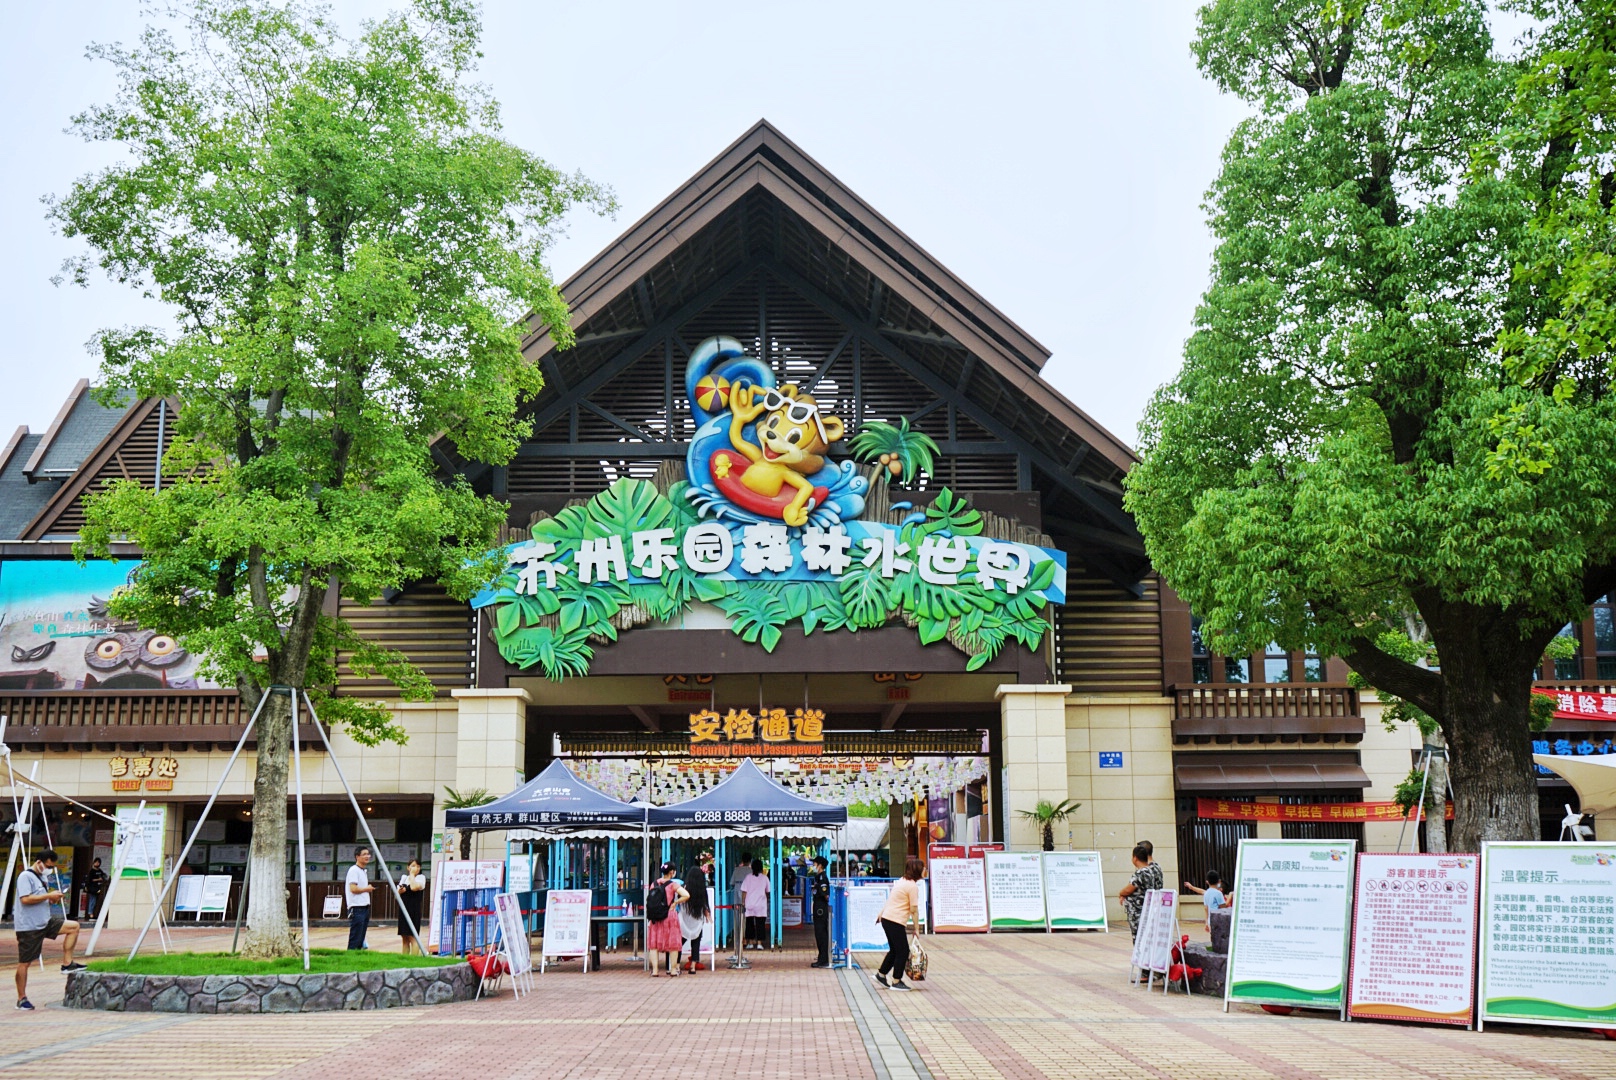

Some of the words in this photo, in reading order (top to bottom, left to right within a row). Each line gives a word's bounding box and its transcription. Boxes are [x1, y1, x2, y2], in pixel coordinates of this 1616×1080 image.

[511, 521, 1031, 596] 苏州乐园森林水世界
[689, 707, 826, 742] 安检通道
[689, 744, 730, 757] Security
[732, 744, 763, 756] Check
[764, 744, 823, 756] Passageway
[109, 756, 179, 778] 售票处
[112, 780, 139, 790] TICKET
[145, 780, 171, 789] OFFICE
[694, 811, 722, 822] 6288
[724, 811, 751, 822] 8888
[1240, 804, 1279, 818] 早发现
[1284, 806, 1323, 818] 早报告
[1330, 806, 1368, 819] 早隔离
[471, 813, 514, 824] 自然无界
[518, 812, 561, 823] 群山墅区
[1262, 860, 1300, 870] 入园须知
[1386, 868, 1448, 878] 游客重要提示
[1501, 869, 1559, 883] 温馨提示
[1494, 894, 1614, 904] 当遇到暴雨、雷电、台风等恶劣
